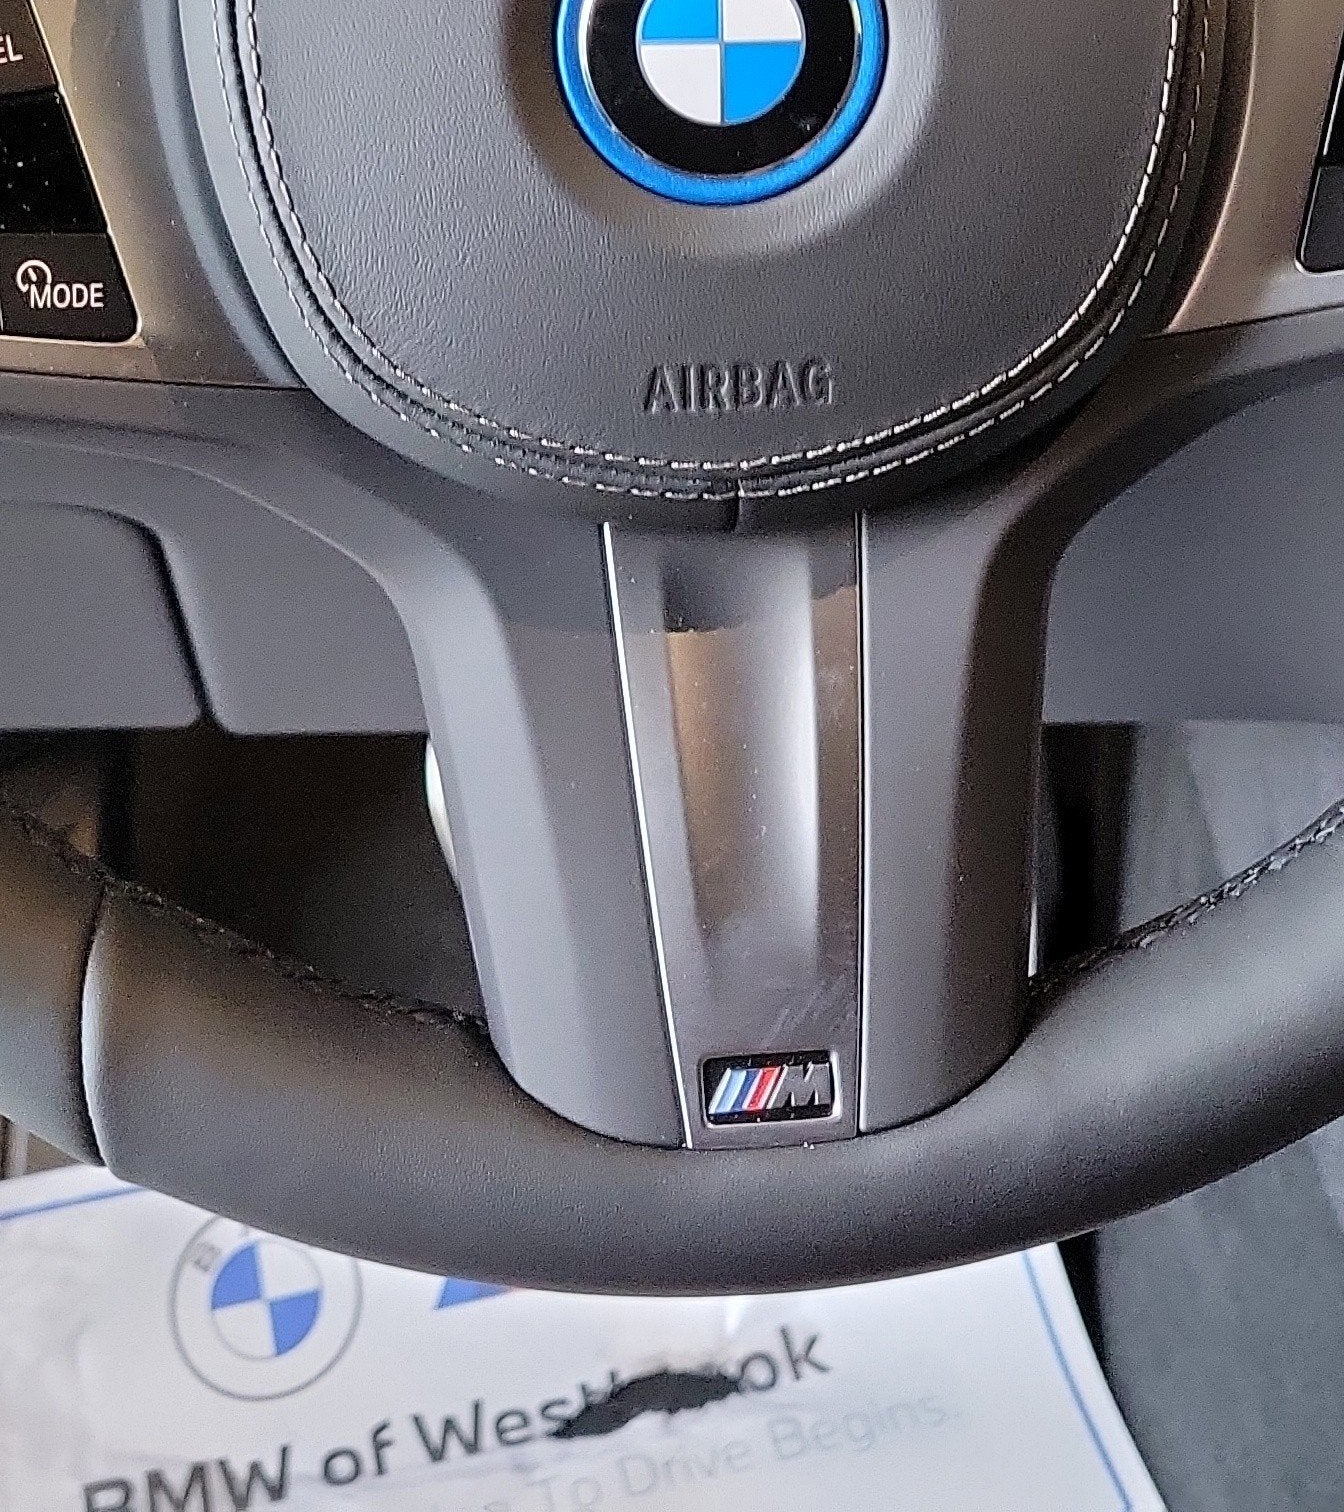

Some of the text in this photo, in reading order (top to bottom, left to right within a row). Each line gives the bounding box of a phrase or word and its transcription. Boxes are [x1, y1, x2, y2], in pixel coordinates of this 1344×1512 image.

[29, 282, 105, 309] MODE
[643, 359, 835, 417] AIRBAG
[322, 1419, 392, 1487] of
[615, 1438, 754, 1498] Drive
